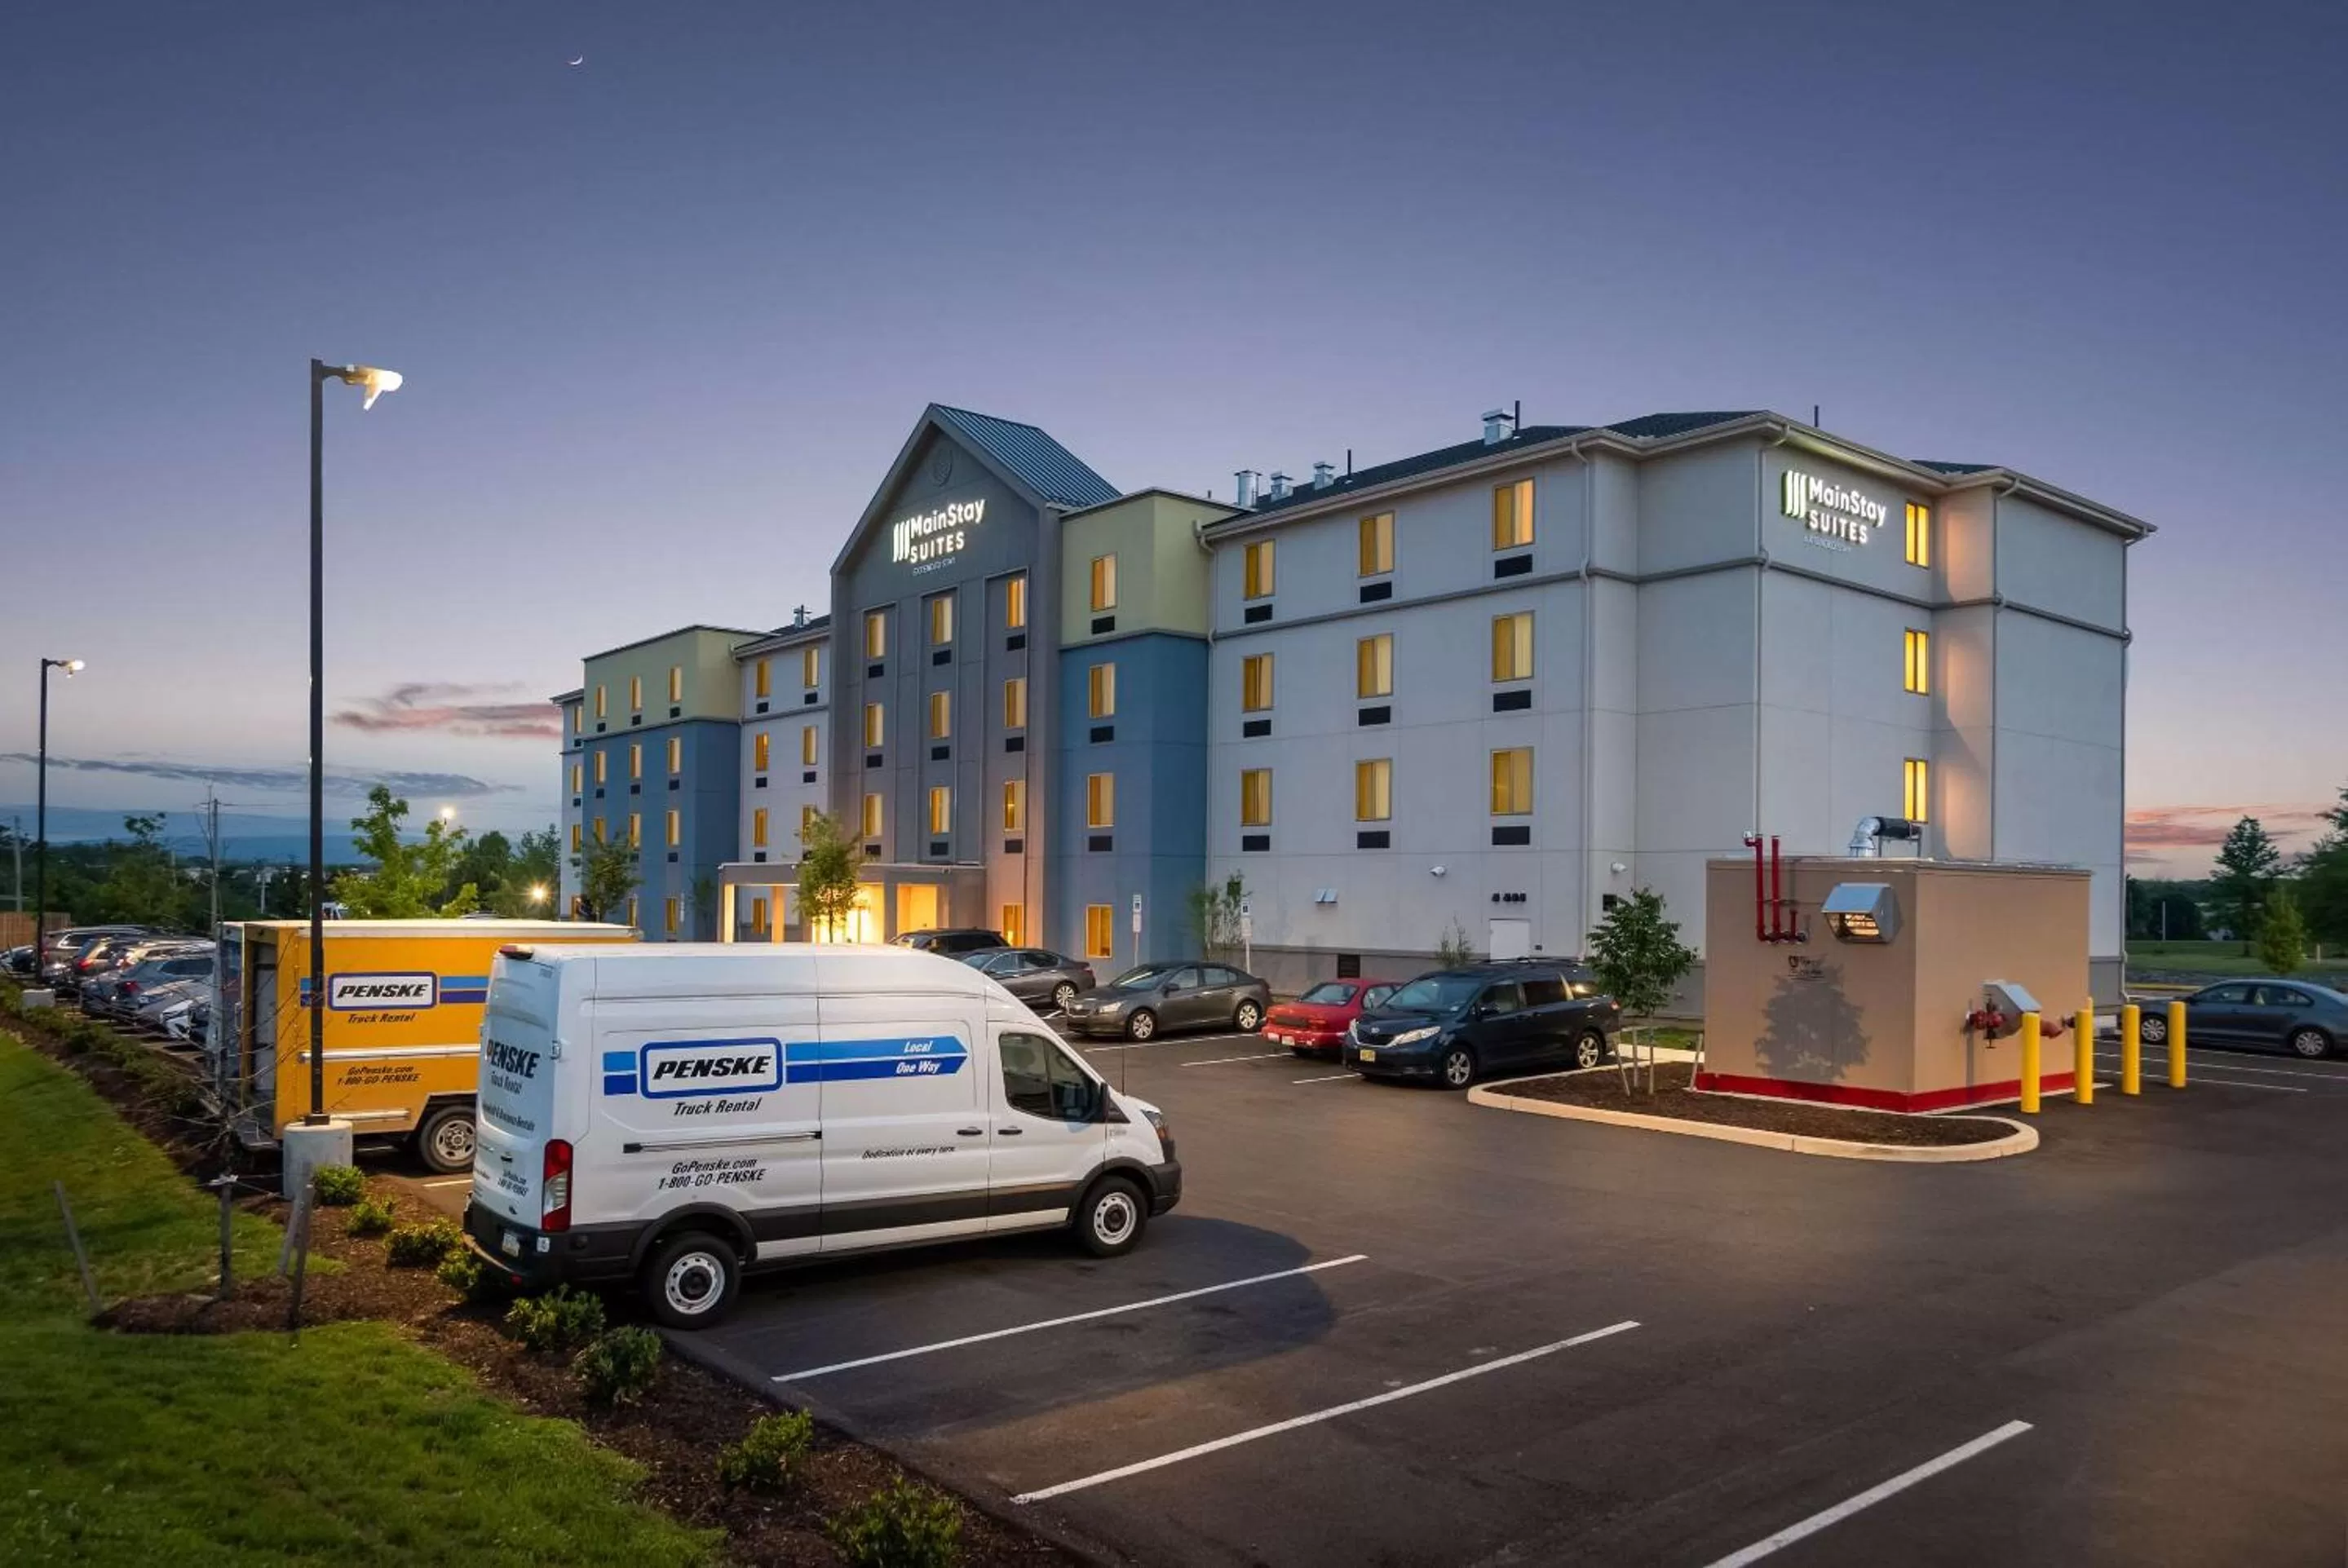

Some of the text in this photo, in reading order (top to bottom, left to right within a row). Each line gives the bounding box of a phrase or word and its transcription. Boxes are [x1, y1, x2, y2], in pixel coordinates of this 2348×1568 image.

[1809, 476, 1886, 528] MainStay
[910, 498, 986, 539] MainStay
[1809, 509, 1868, 545] SUITES
[910, 531, 966, 564] SUITES
[337, 983, 428, 999] PENSKE
[347, 1012, 416, 1023] Truck Rental
[904, 1040, 933, 1053] Local
[486, 1039, 541, 1079] PENSKE
[653, 1055, 772, 1080] PENSKE
[895, 1060, 941, 1074] One Way
[674, 1097, 763, 1115] Truck Rental
[915, 1146, 937, 1158] every
[672, 1158, 758, 1174] GoPenske.com
[659, 1168, 767, 1190] 1-800-GO-PENSKE
